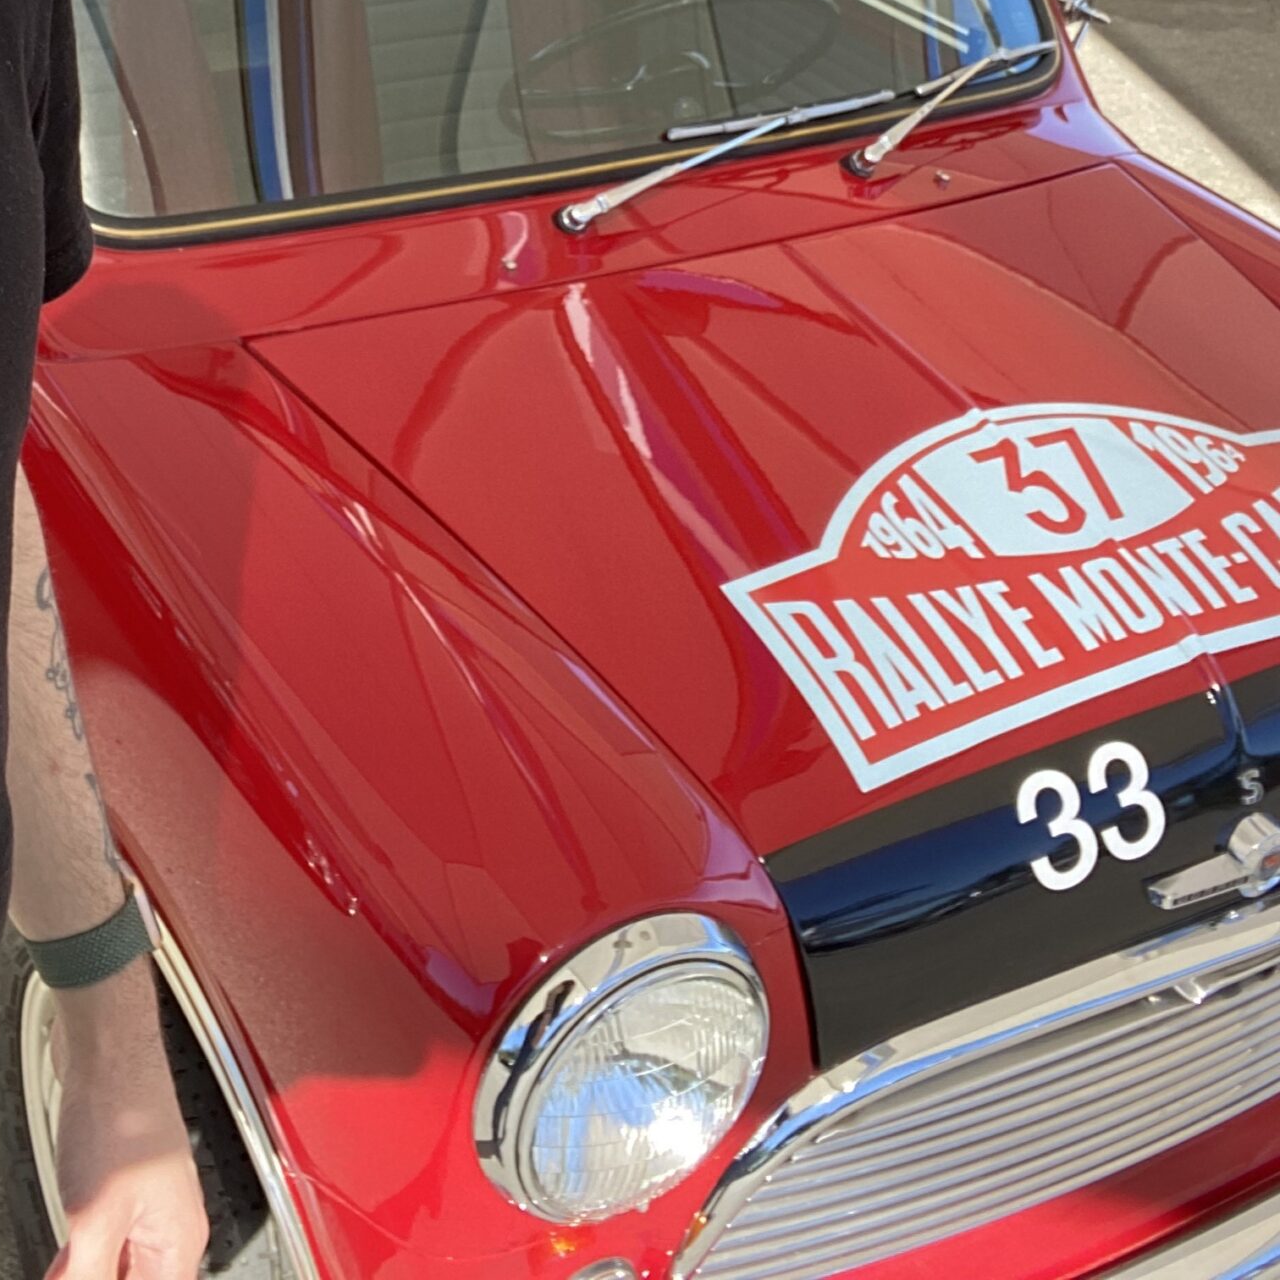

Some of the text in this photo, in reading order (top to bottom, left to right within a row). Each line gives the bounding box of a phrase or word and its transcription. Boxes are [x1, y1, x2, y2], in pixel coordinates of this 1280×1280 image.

[968, 426, 1124, 535] 37
[1128, 420, 1246, 495] 1964
[860, 473, 986, 560] 1964
[763, 486, 1280, 742] RALLYE MONTE-C
[1016, 740, 1166, 891] 33
